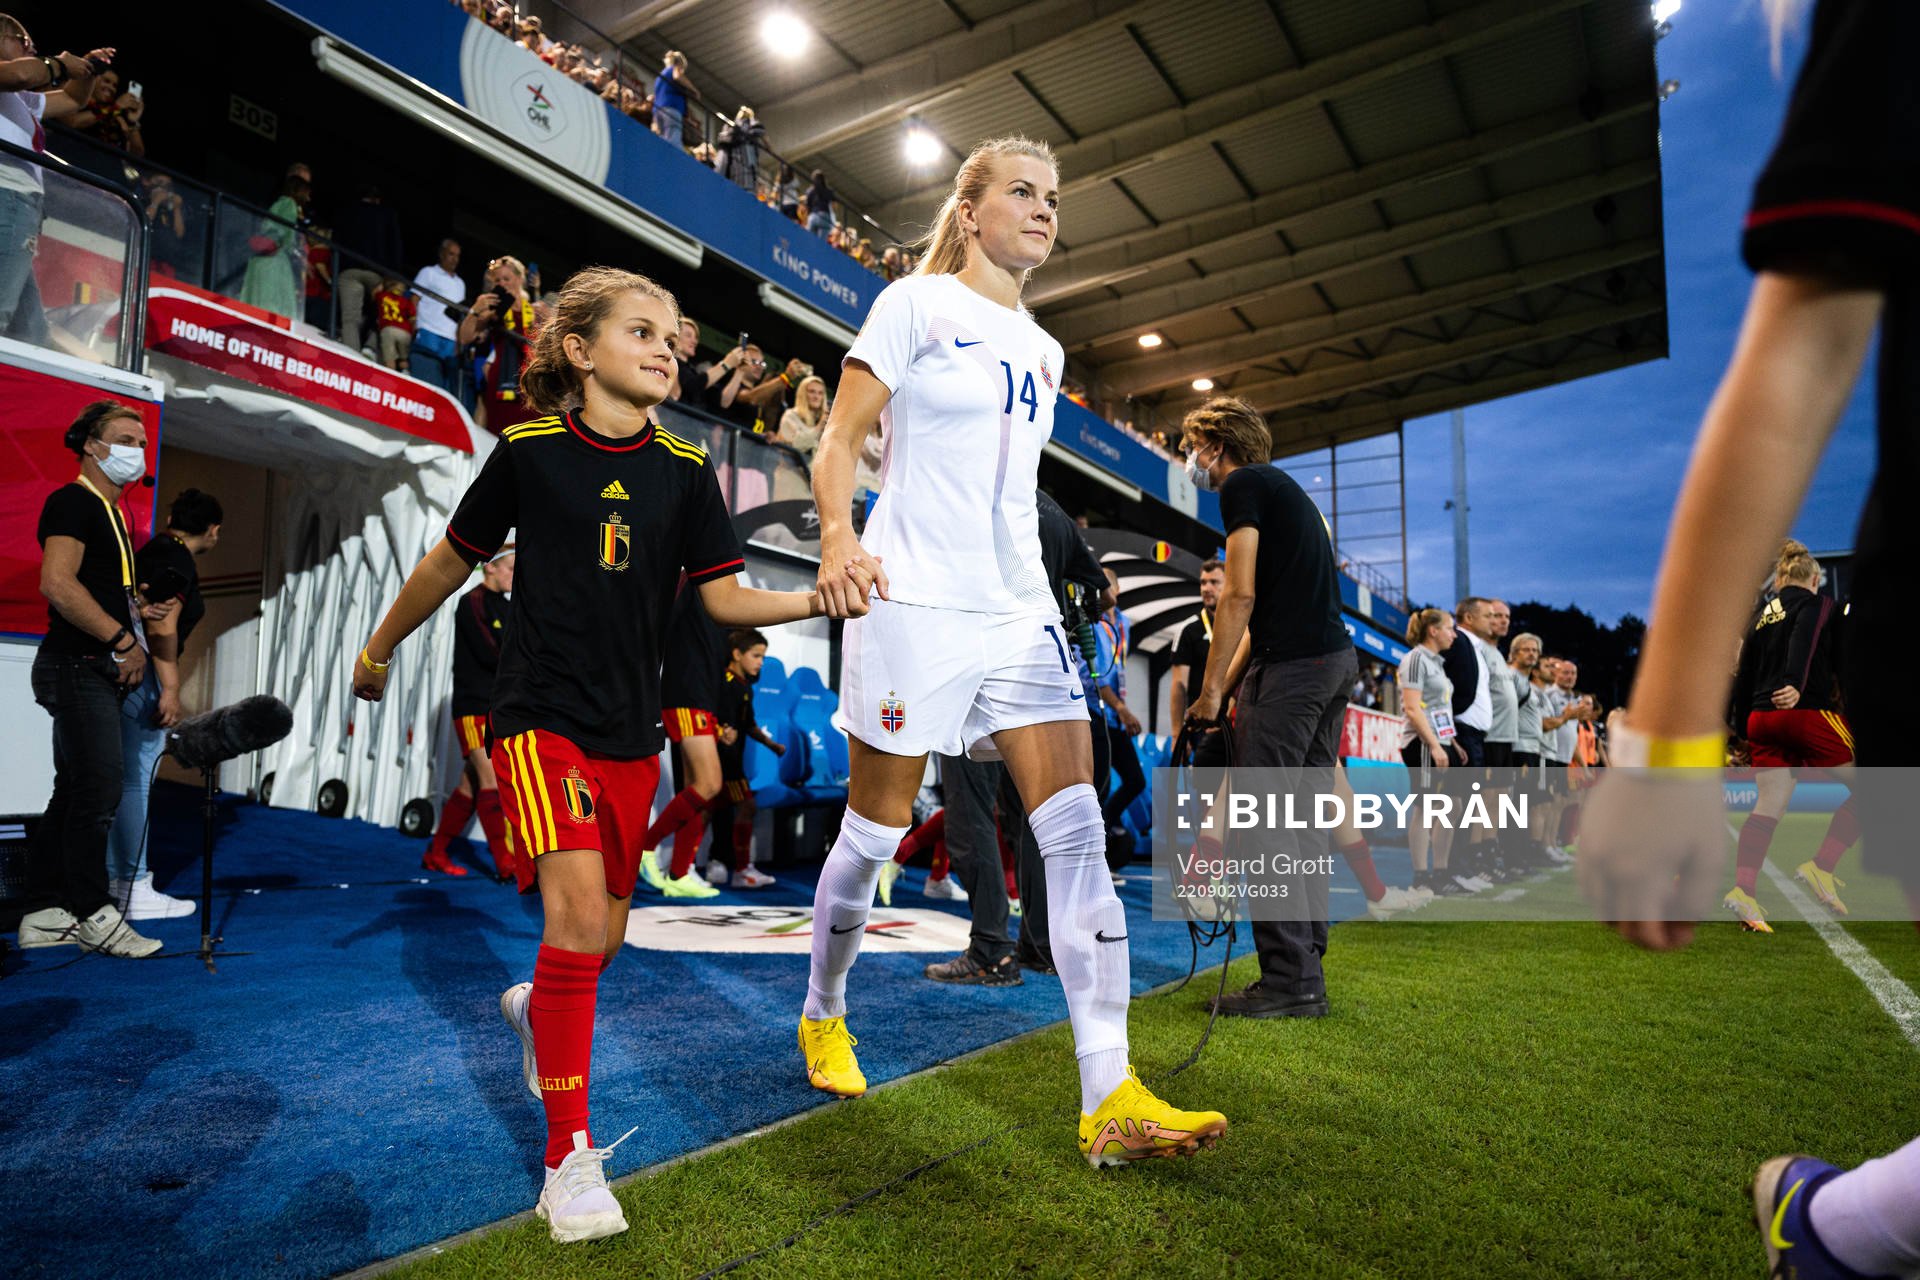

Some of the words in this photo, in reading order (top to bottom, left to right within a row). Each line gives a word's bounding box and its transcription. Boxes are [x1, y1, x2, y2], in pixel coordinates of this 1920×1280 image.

[231, 98, 275, 135] 305
[773, 244, 810, 280] KING
[812, 268, 858, 309] POWER
[171, 317, 226, 352] HOME
[227, 337, 251, 359] OF
[252, 345, 285, 371] THE
[285, 357, 351, 394] BELGIAN
[352, 380, 382, 404] RED
[382, 391, 436, 423] FLAMES
[1000, 360, 1038, 422] 14
[1044, 625, 1077, 674] 1
